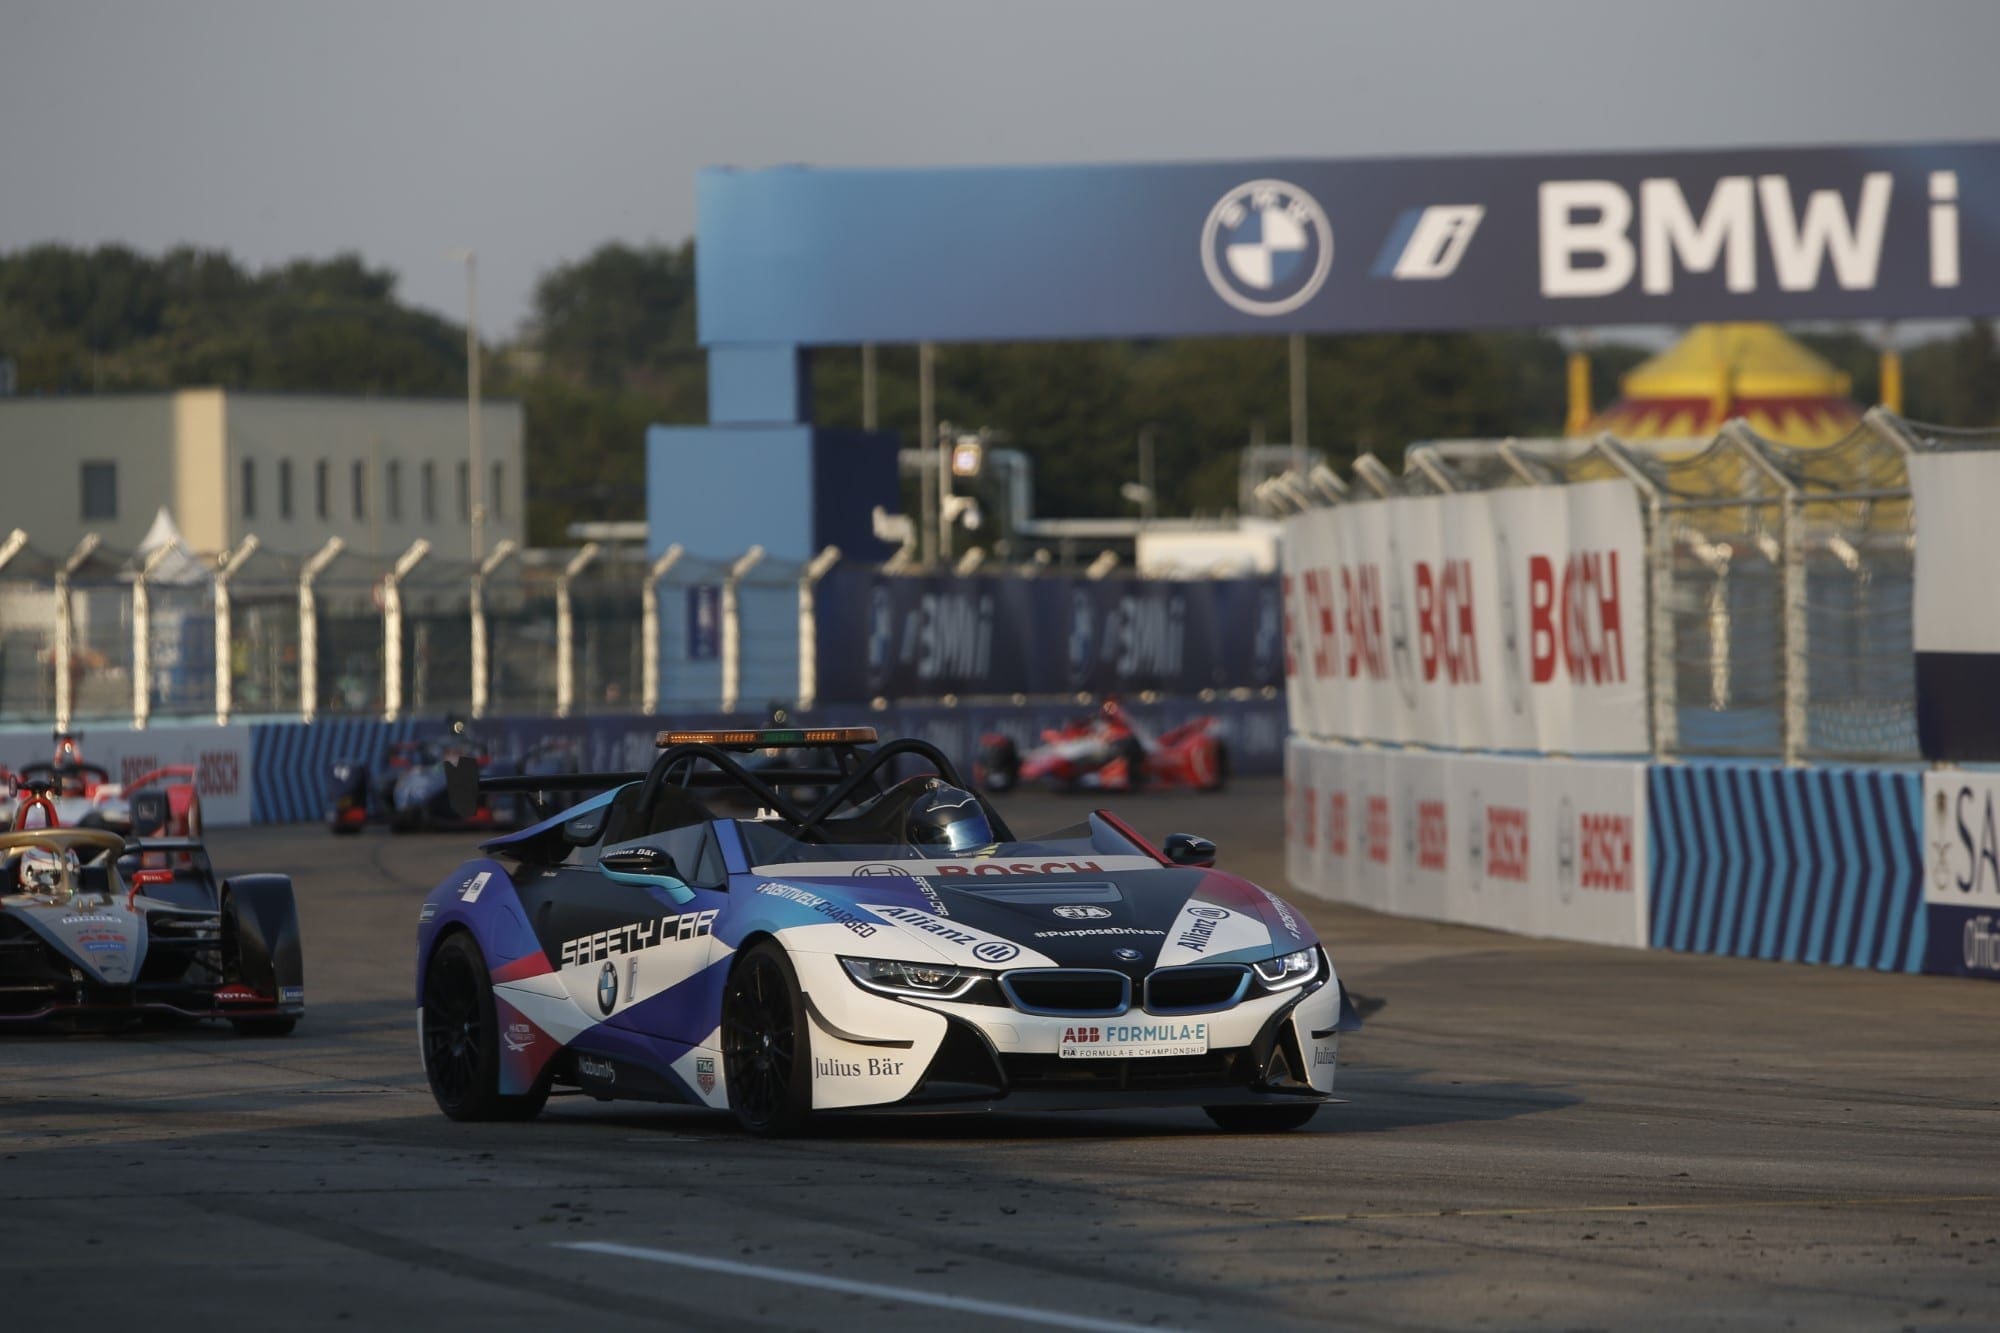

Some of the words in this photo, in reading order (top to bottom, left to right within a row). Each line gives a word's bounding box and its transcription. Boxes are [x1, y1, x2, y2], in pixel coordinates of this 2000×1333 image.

[1539, 172, 1892, 298] BMW
[1929, 170, 1960, 287] i
[202, 750, 239, 797] BOSCH
[636, 848, 657, 857] Bär
[1581, 811, 1634, 891] BOSCH
[936, 861, 1105, 876] BOSCH
[912, 876, 938, 901] SAFETY
[929, 901, 950, 917] CAR
[561, 920, 655, 967] SAFETY
[659, 908, 720, 945] CAR
[876, 907, 978, 945] Allianz
[1033, 926, 1166, 938] #PurposeDriven
[1177, 918, 1217, 953] Allianz
[1063, 1027, 1100, 1043] ABB
[1138, 1046, 1205, 1056] CHAMPIONSHIP
[698, 1061, 713, 1072] TAG
[815, 1057, 861, 1079] Julius
[867, 1057, 904, 1077] Bär
